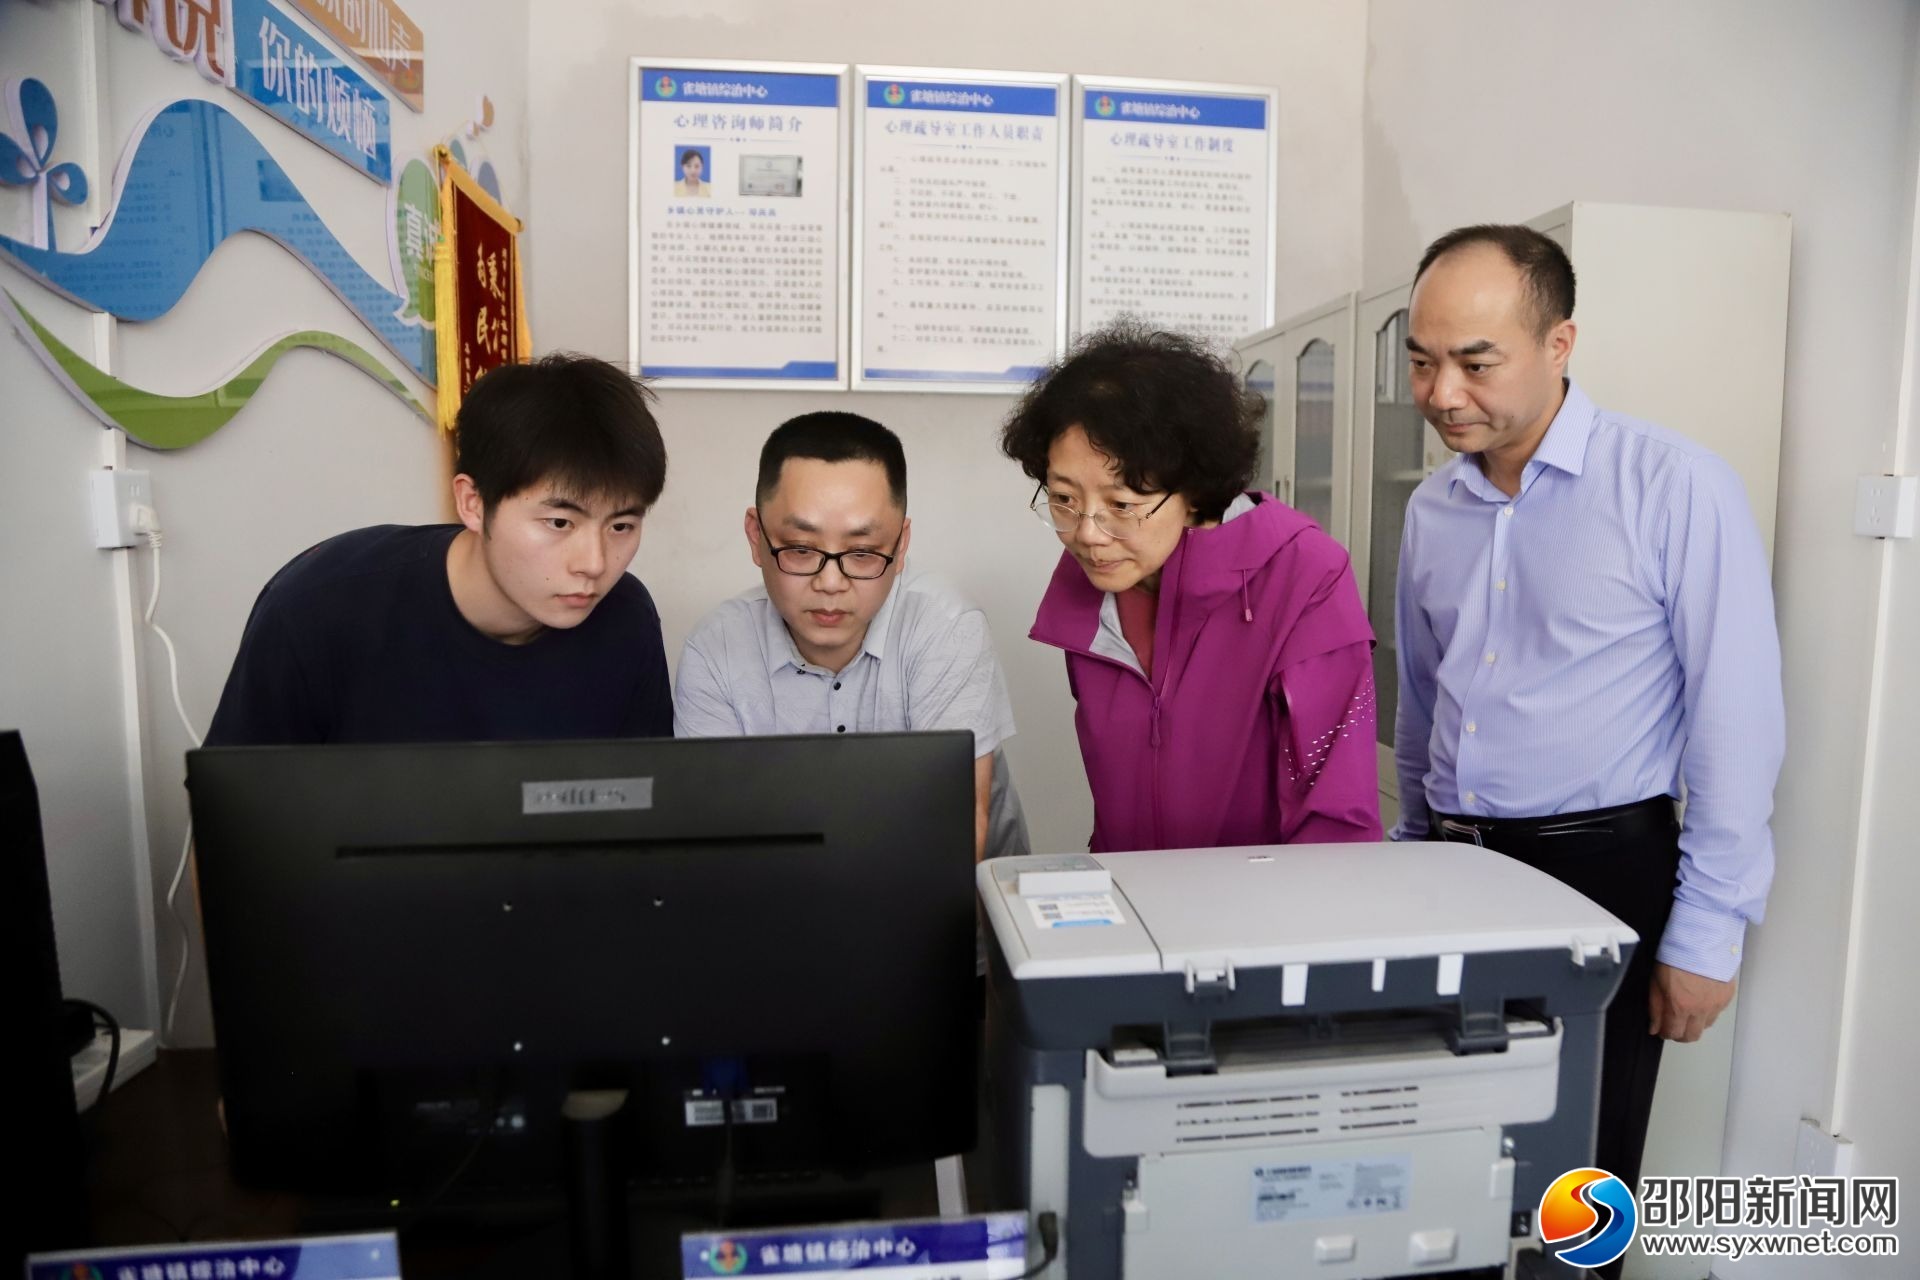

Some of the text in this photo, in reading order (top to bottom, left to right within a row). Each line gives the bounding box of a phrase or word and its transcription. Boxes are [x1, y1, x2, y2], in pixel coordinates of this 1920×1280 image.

[259, 15, 377, 161] 你的烦恼
[673, 113, 803, 133] 心理咨询师简介
[884, 119, 1045, 142] 心理疏导室工作人员职责
[1109, 131, 1235, 153] 心理疏导室工作制度
[759, 1238, 916, 1266] 雀塘镇综治中心
